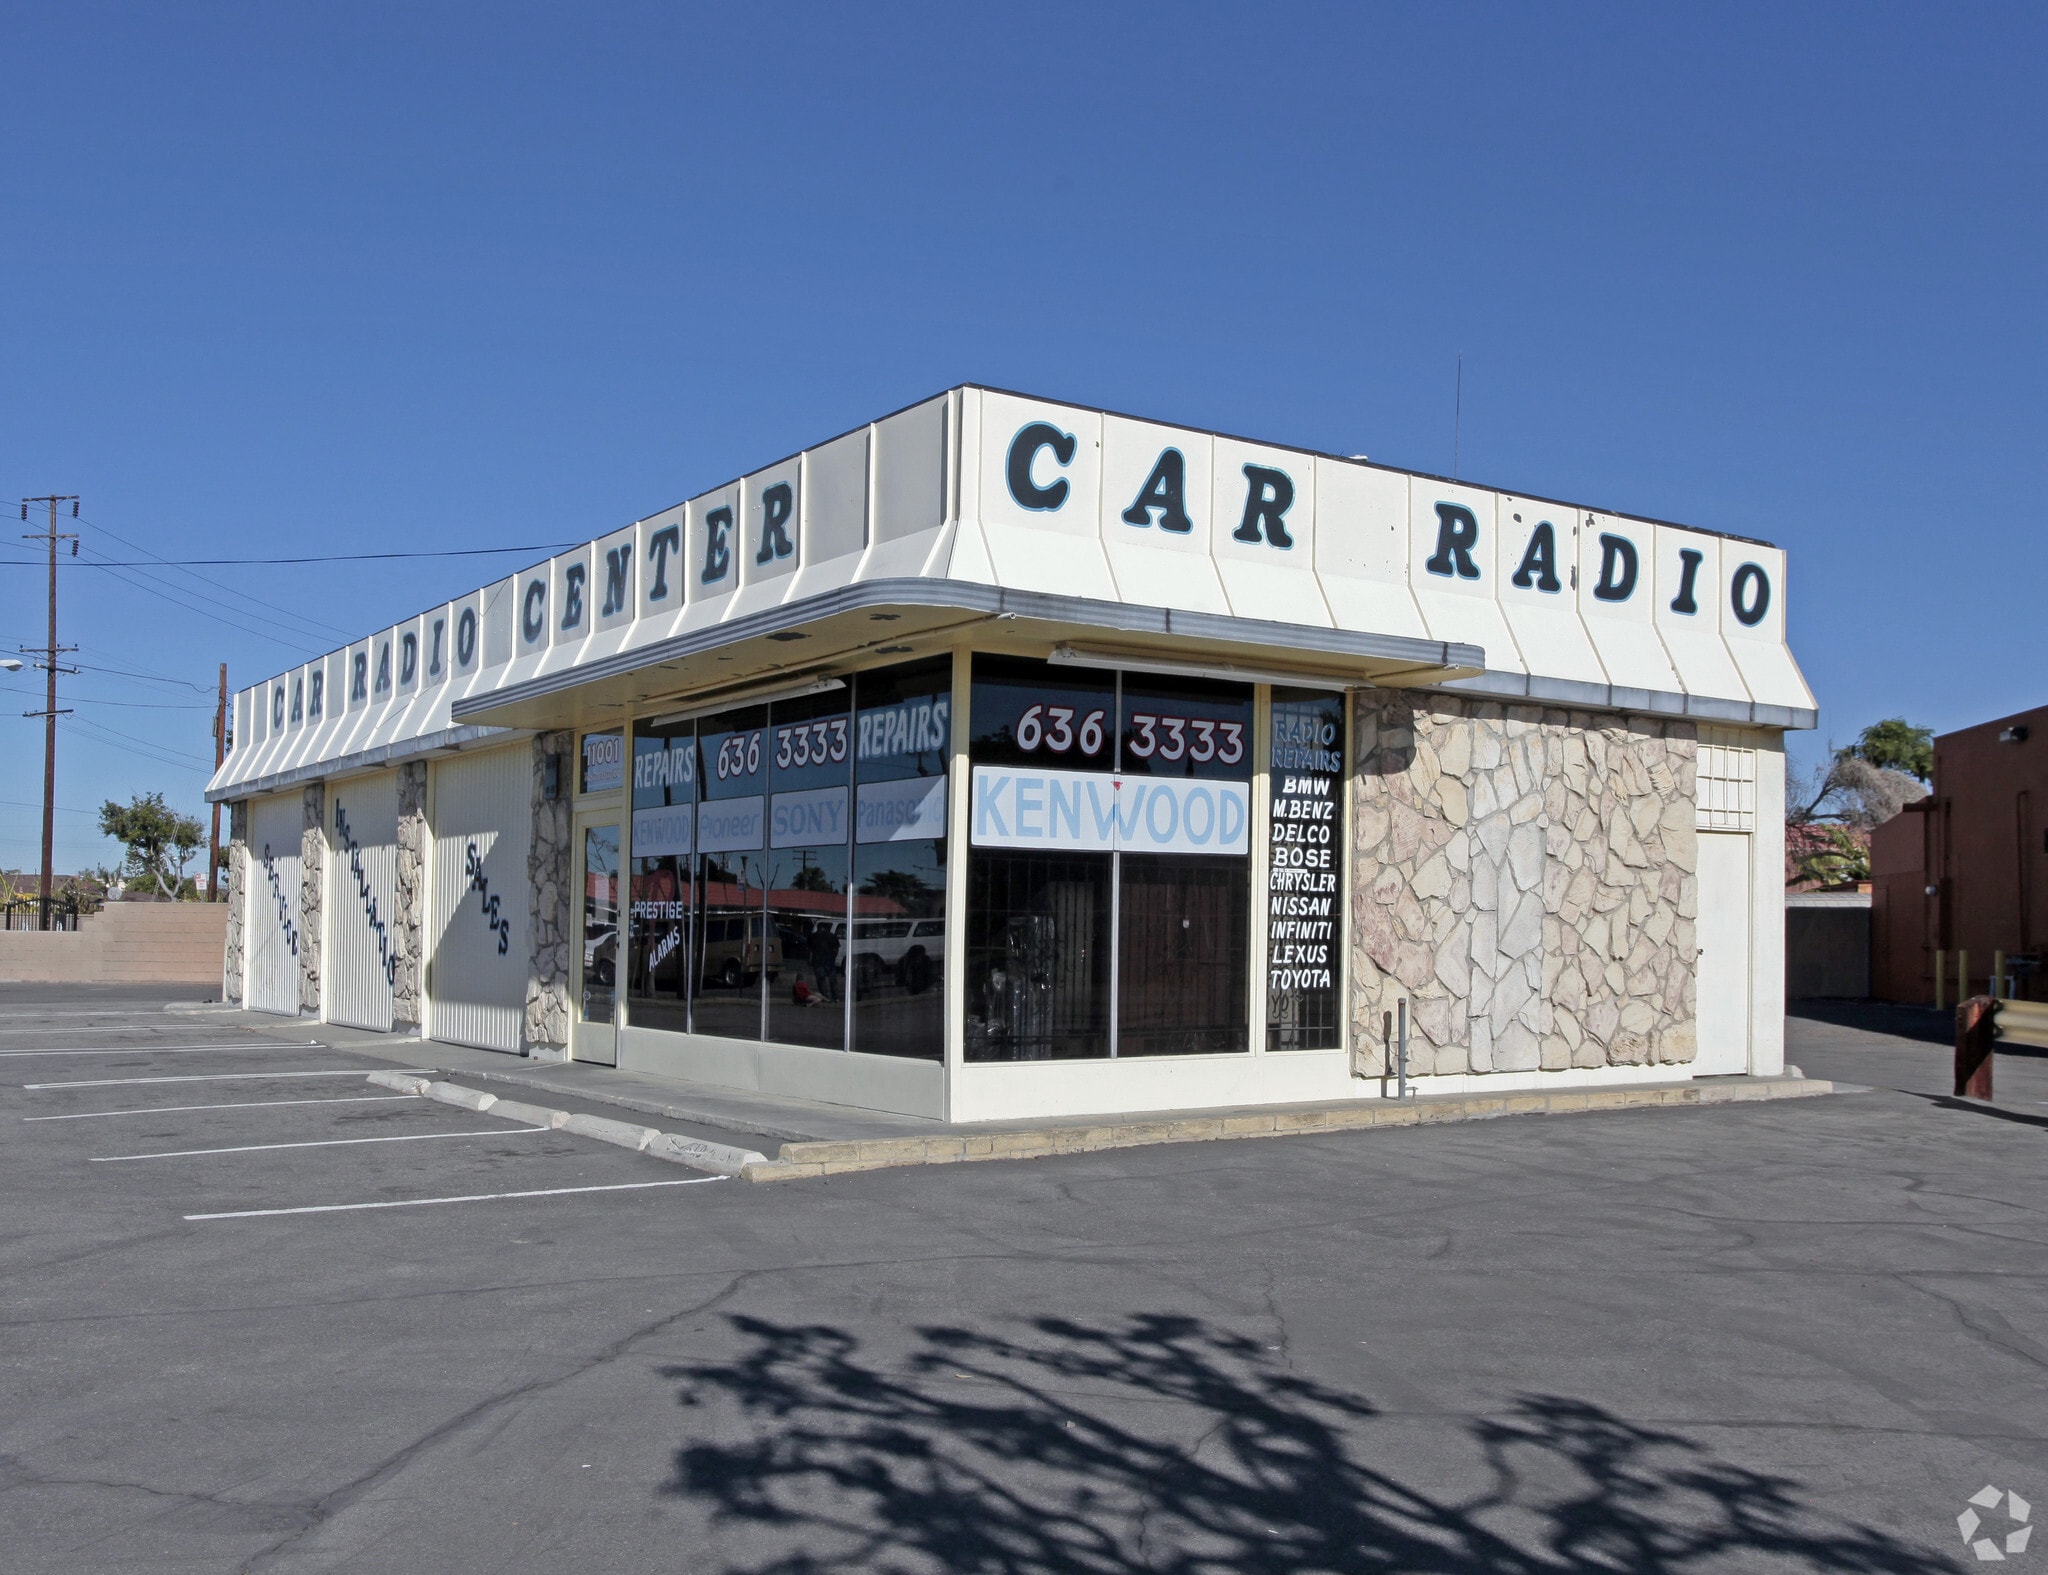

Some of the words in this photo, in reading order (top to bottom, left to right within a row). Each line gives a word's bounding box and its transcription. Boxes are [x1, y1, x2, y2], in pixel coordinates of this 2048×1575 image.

[1005, 420, 1296, 550] CAR
[1425, 500, 1772, 627] RADIO
[273, 670, 324, 729] CAR
[352, 606, 476, 701] RADIO
[523, 480, 793, 643] CENTER
[858, 702, 948, 760] REPAIRS
[1016, 703, 1105, 757] 636
[1128, 712, 1244, 765] 3333
[1275, 720, 1336, 746] RADIO
[587, 738, 619, 767] 11001
[717, 730, 762, 782] 636
[775, 717, 849, 771] 3333
[1271, 746, 1342, 773] REPAIRS
[634, 744, 695, 789] REPAIRS
[1282, 775, 1331, 796] BMW
[774, 799, 844, 836] SONY
[975, 774, 1245, 846] KENWOOD
[1272, 798, 1335, 820] M.BENZ
[634, 815, 690, 848] KENWOOD
[699, 812, 761, 840] Pioneer
[1272, 823, 1331, 844] DELCO
[1273, 847, 1332, 868] BOSE
[335, 798, 396, 986] INSTALLATIO
[1269, 871, 1336, 892] CHRYSLER
[263, 843, 298, 957] SERVICE
[466, 843, 509, 956] SALES
[634, 901, 683, 919] PRESTIGE
[1271, 896, 1332, 916] NISSAN
[1270, 921, 1333, 940] INFINITI
[648, 925, 681, 973] ALARMS
[1272, 945, 1328, 964] LEXUS
[1271, 968, 1331, 990] TOYOTA
